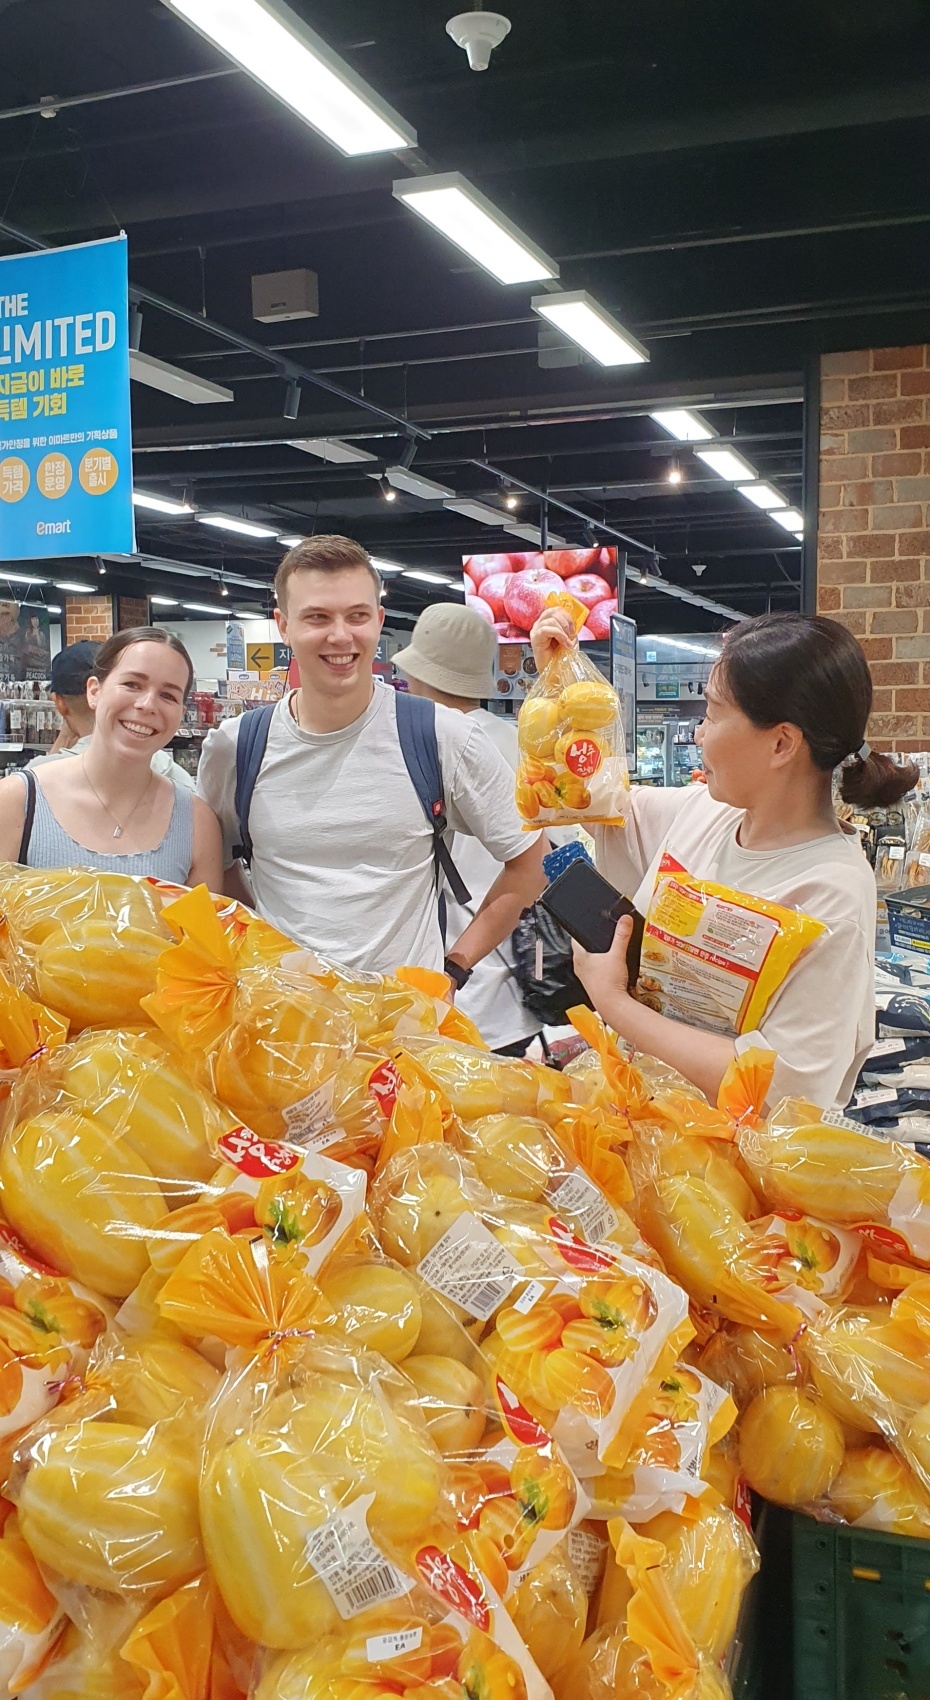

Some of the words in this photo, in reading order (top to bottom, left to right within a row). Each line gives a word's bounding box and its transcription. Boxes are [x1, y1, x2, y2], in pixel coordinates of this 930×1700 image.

[0, 369, 44, 395] 지금이
[50, 364, 84, 389] 바로
[33, 392, 67, 417] 기회
[0, 438, 30, 450] 가안정을
[32, 436, 46, 447] 위한
[86, 428, 118, 441] 기획상품
[44, 461, 65, 476] 한정
[84, 456, 111, 472] 분기별
[3, 465, 23, 479] 득템
[88, 472, 106, 487] 출시
[3, 480, 23, 494] 가격
[44, 477, 65, 491] 운영
[36, 519, 71, 535] emart
[394, 1642, 405, 1650] EA
